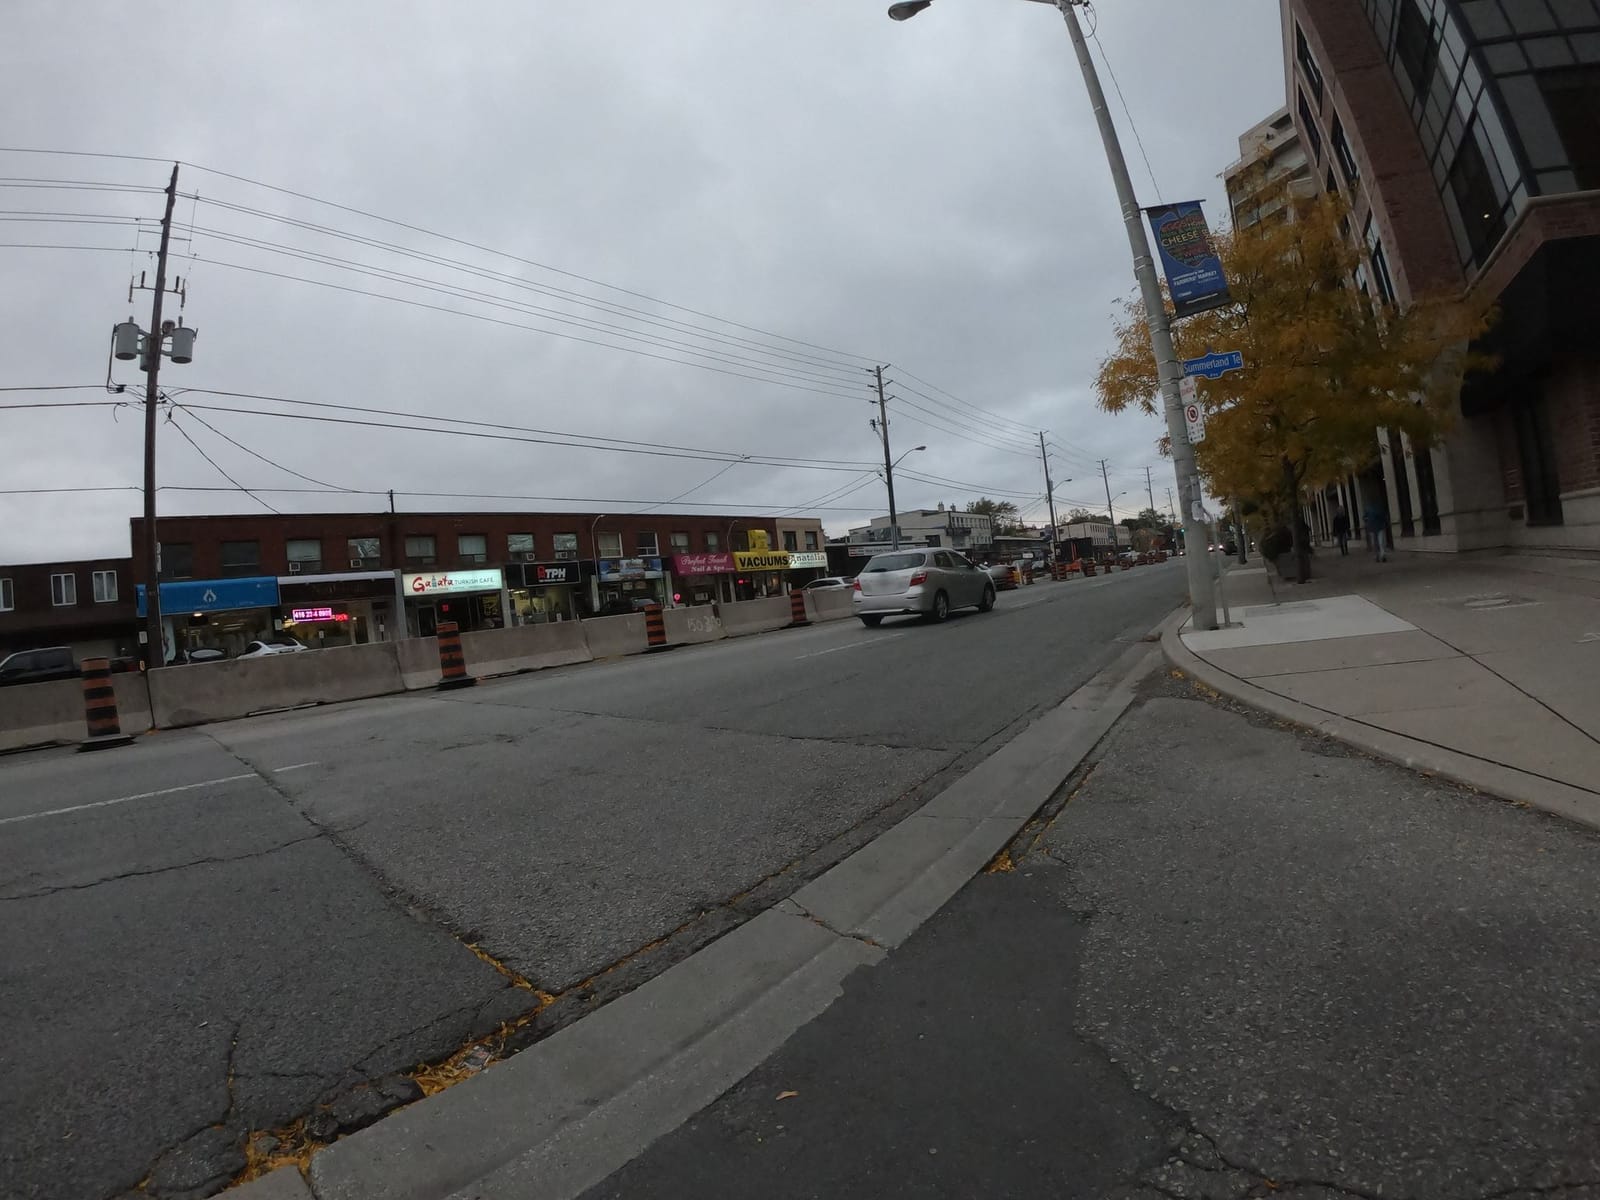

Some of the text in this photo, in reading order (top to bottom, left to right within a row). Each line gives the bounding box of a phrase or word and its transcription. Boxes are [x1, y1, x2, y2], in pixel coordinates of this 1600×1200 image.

[1161, 230, 1199, 247] CHEESE
[1184, 354, 1241, 373] Summerland Te
[739, 555, 789, 568] VACUUMS
[545, 567, 566, 579] TPH
